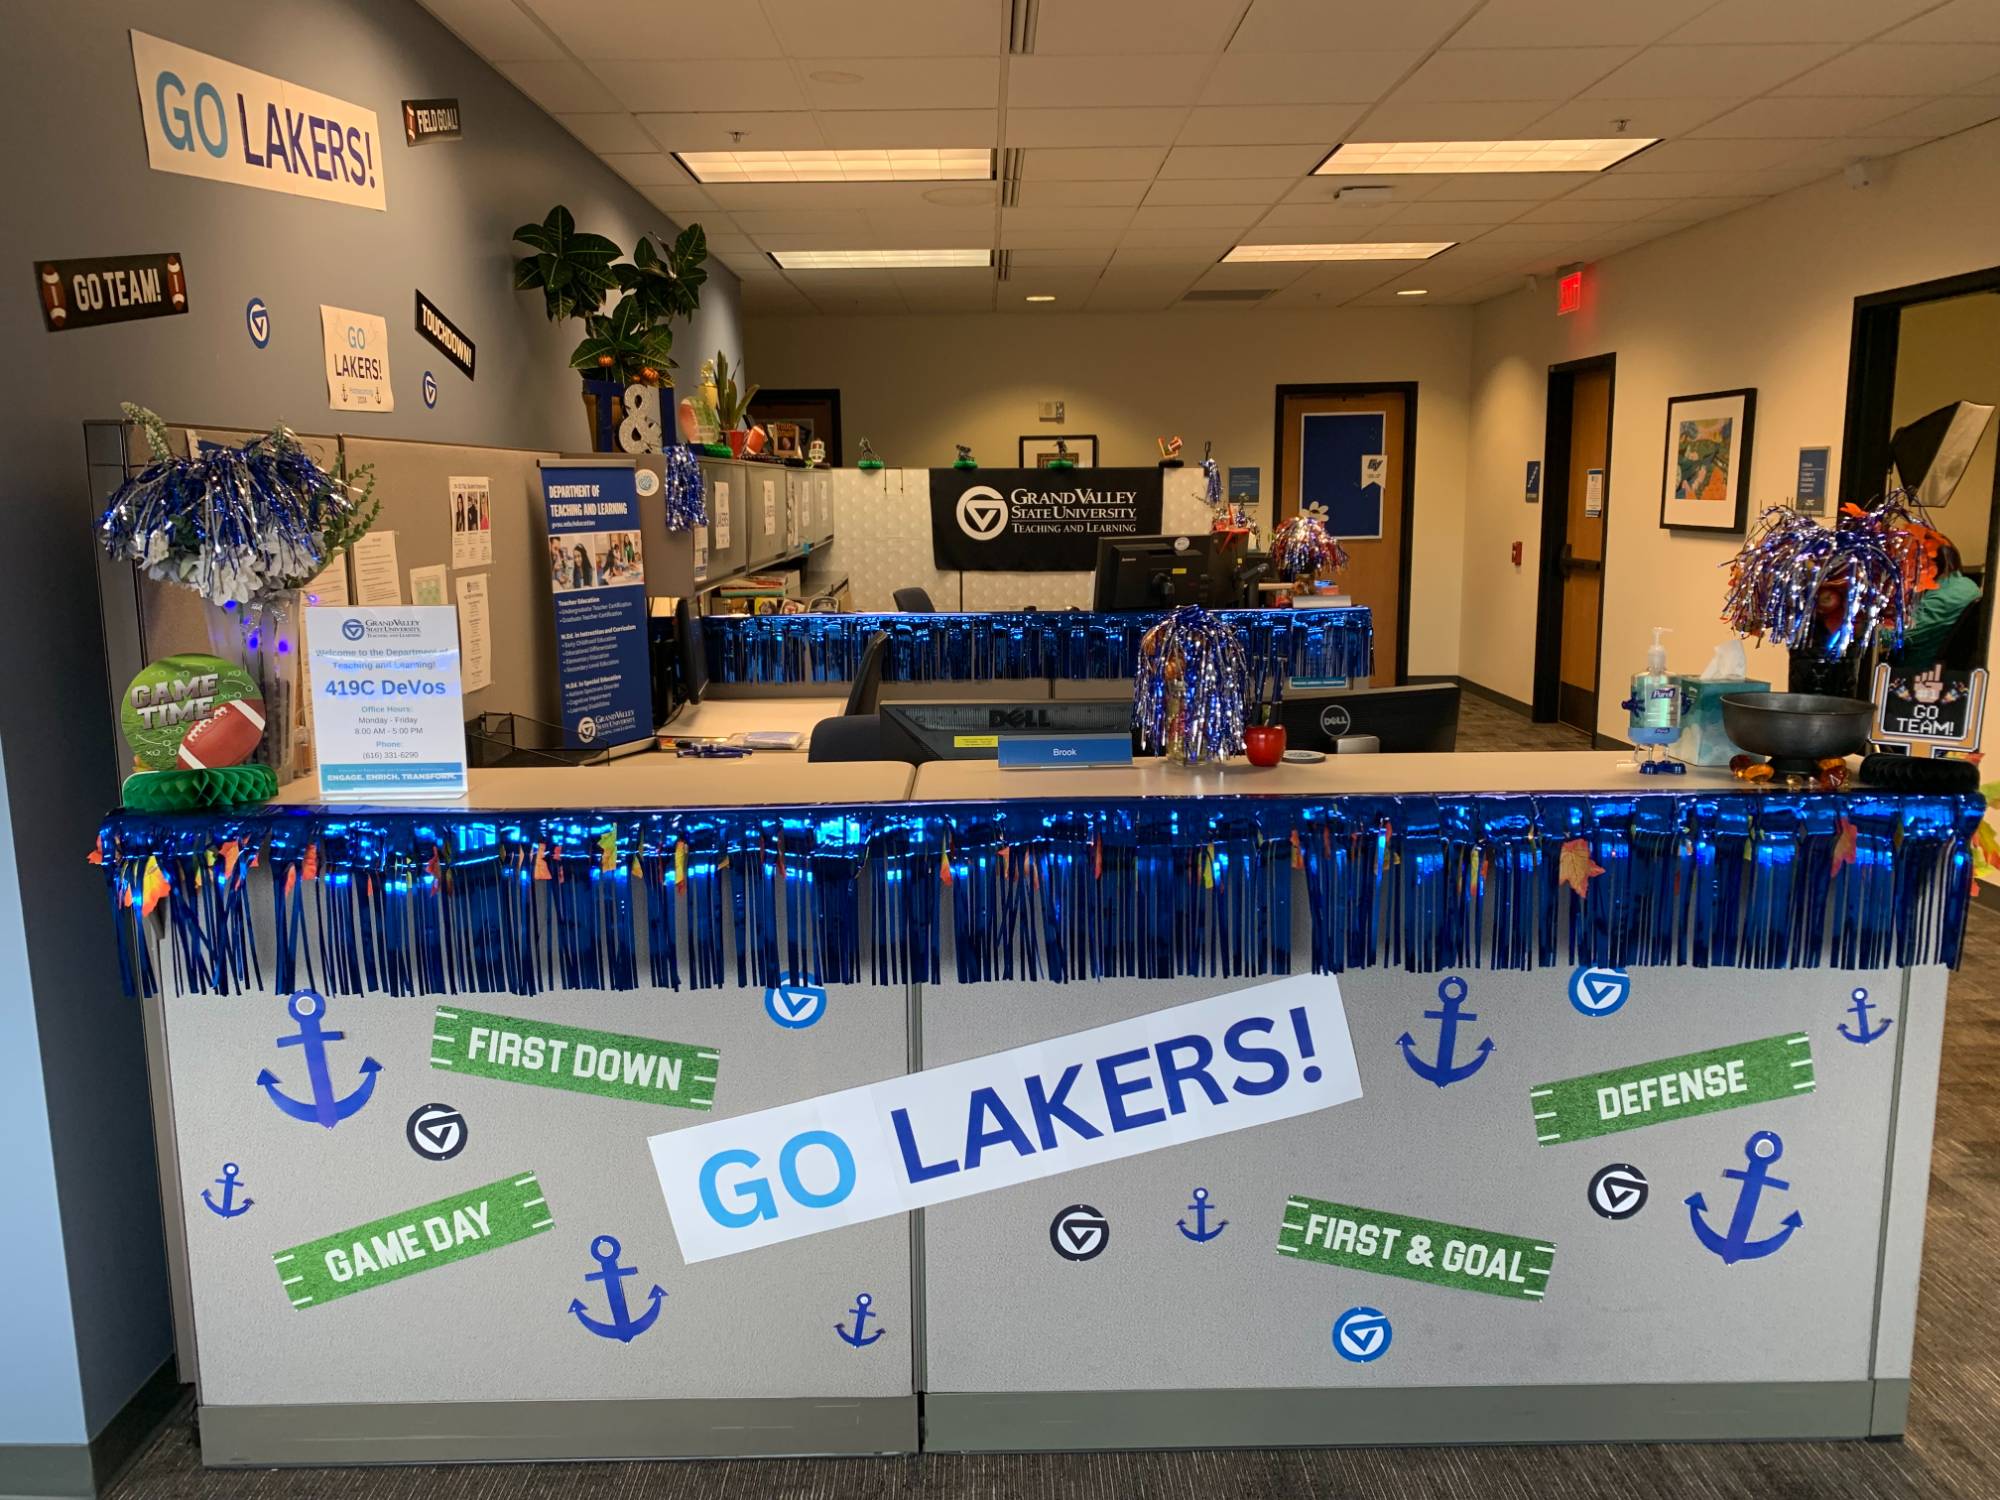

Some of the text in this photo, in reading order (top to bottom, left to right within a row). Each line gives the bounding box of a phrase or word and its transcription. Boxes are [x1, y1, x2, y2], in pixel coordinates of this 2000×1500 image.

[156, 70, 376, 189] GO LAKERS!
[417, 108, 458, 133] FIELD GOAL!
[73, 268, 162, 311] GO TEAM!
[348, 326, 365, 349] GO
[422, 303, 471, 368] TOUCHDOWN!
[334, 353, 382, 380] LAKERS!
[619, 384, 662, 454] &
[549, 485, 600, 498] DEPARTMENT OF
[1011, 488, 1137, 505] GRAND VALLEY
[550, 502, 628, 517] TEACHING AND LEARNING
[1011, 506, 1137, 519] STATE UNIVERSITY
[1012, 522, 1137, 533] TEACHING AND LEARNING
[316, 648, 357, 656] Welcome
[370, 648, 384, 656] the
[386, 648, 435, 658] Department
[333, 662, 373, 670] Teaching
[131, 673, 219, 708] GAME
[325, 679, 446, 695] 419C DeVos
[137, 697, 214, 730] TIME
[359, 717, 387, 725] Monday
[395, 716, 417, 724] Friday
[989, 709, 1051, 727] DELL
[1324, 716, 1347, 725] DELL
[1914, 704, 1938, 719] GO
[1896, 717, 1954, 736] TEAM!
[1053, 748, 1077, 756] Brook
[401, 773, 457, 781] TRANSFORM.
[468, 1027, 682, 1091] FIRST DOWN
[1597, 1060, 1748, 1120] DEFENSE
[698, 1006, 1324, 1229] GO LAKERS!
[324, 1201, 491, 1283] GAME DAY
[1304, 1213, 1525, 1283] FIRST & GOAL
